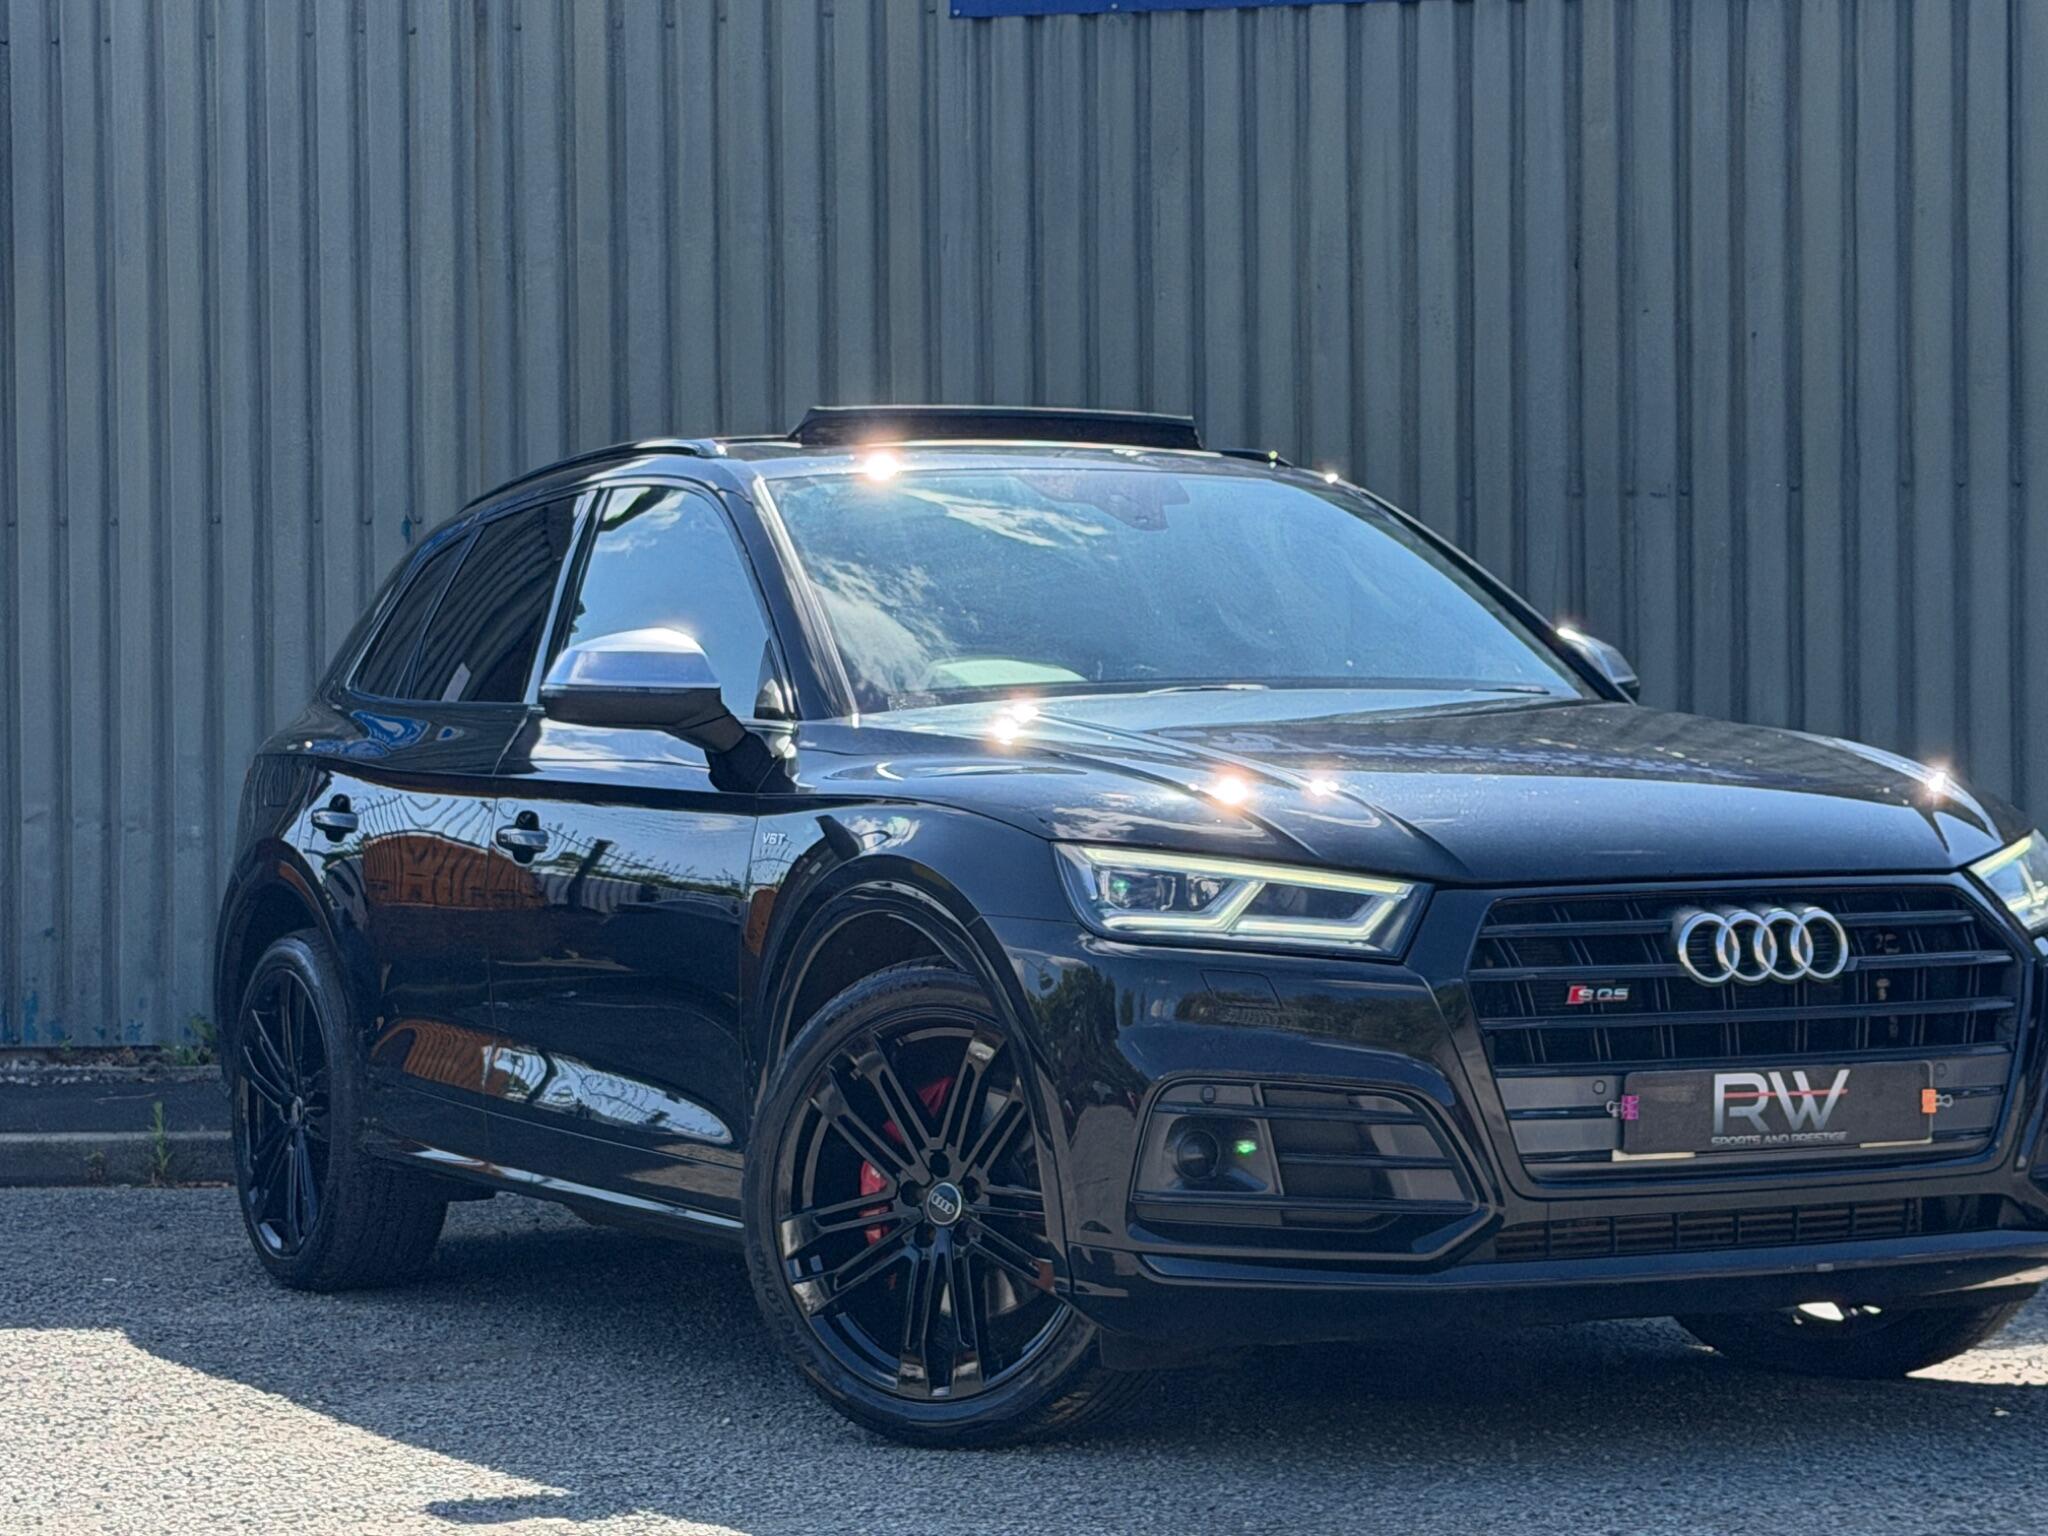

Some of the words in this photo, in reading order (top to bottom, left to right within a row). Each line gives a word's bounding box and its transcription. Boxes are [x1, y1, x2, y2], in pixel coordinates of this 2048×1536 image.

[1575, 987, 1629, 1002] SQ5
[1713, 1069, 1850, 1133] RW
[1711, 1135, 1760, 1146] SPORTS
[1764, 1133, 1790, 1145] AND
[1791, 1131, 1848, 1142] PRESTIGE
